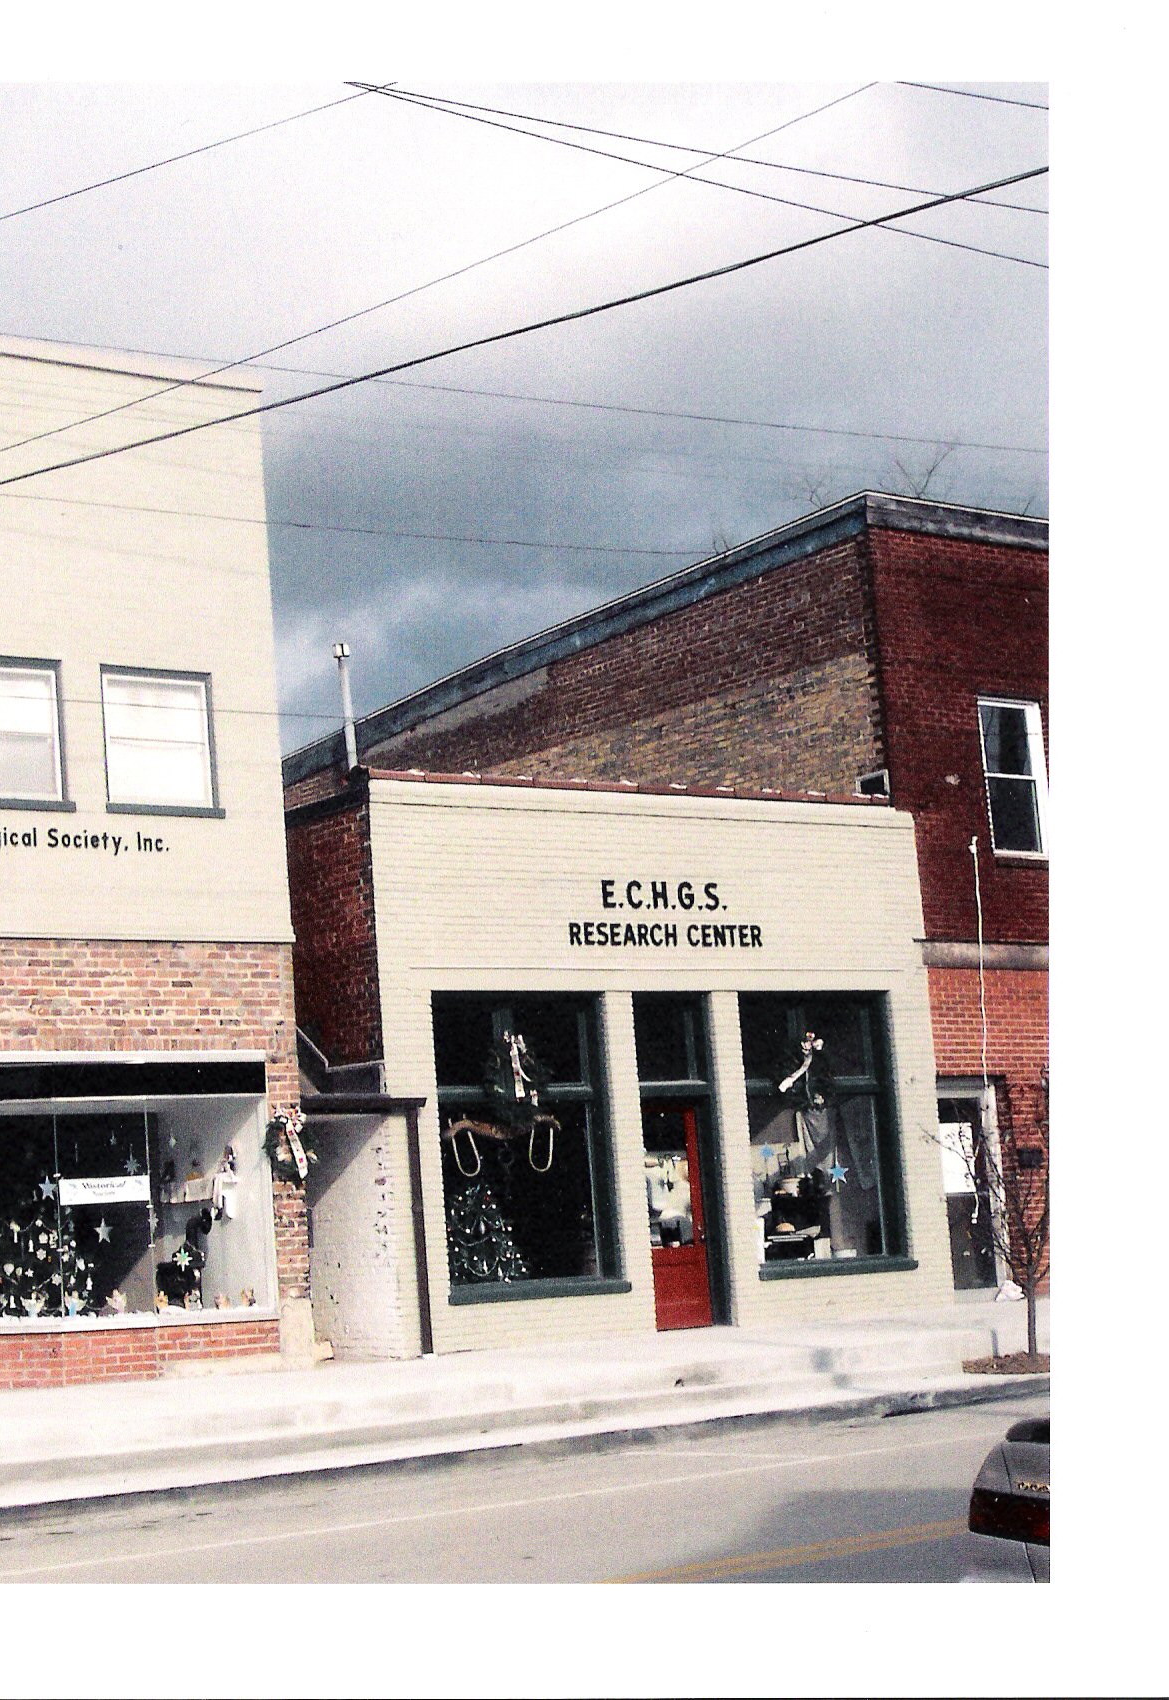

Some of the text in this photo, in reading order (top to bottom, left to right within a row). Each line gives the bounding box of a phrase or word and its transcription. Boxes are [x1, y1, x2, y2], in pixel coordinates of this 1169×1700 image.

[47, 828, 130, 856] Society,
[136, 831, 170, 853] Inc.
[600, 879, 728, 912] E.C.H.G.S.
[568, 921, 763, 948] RESEARCH CENTER
